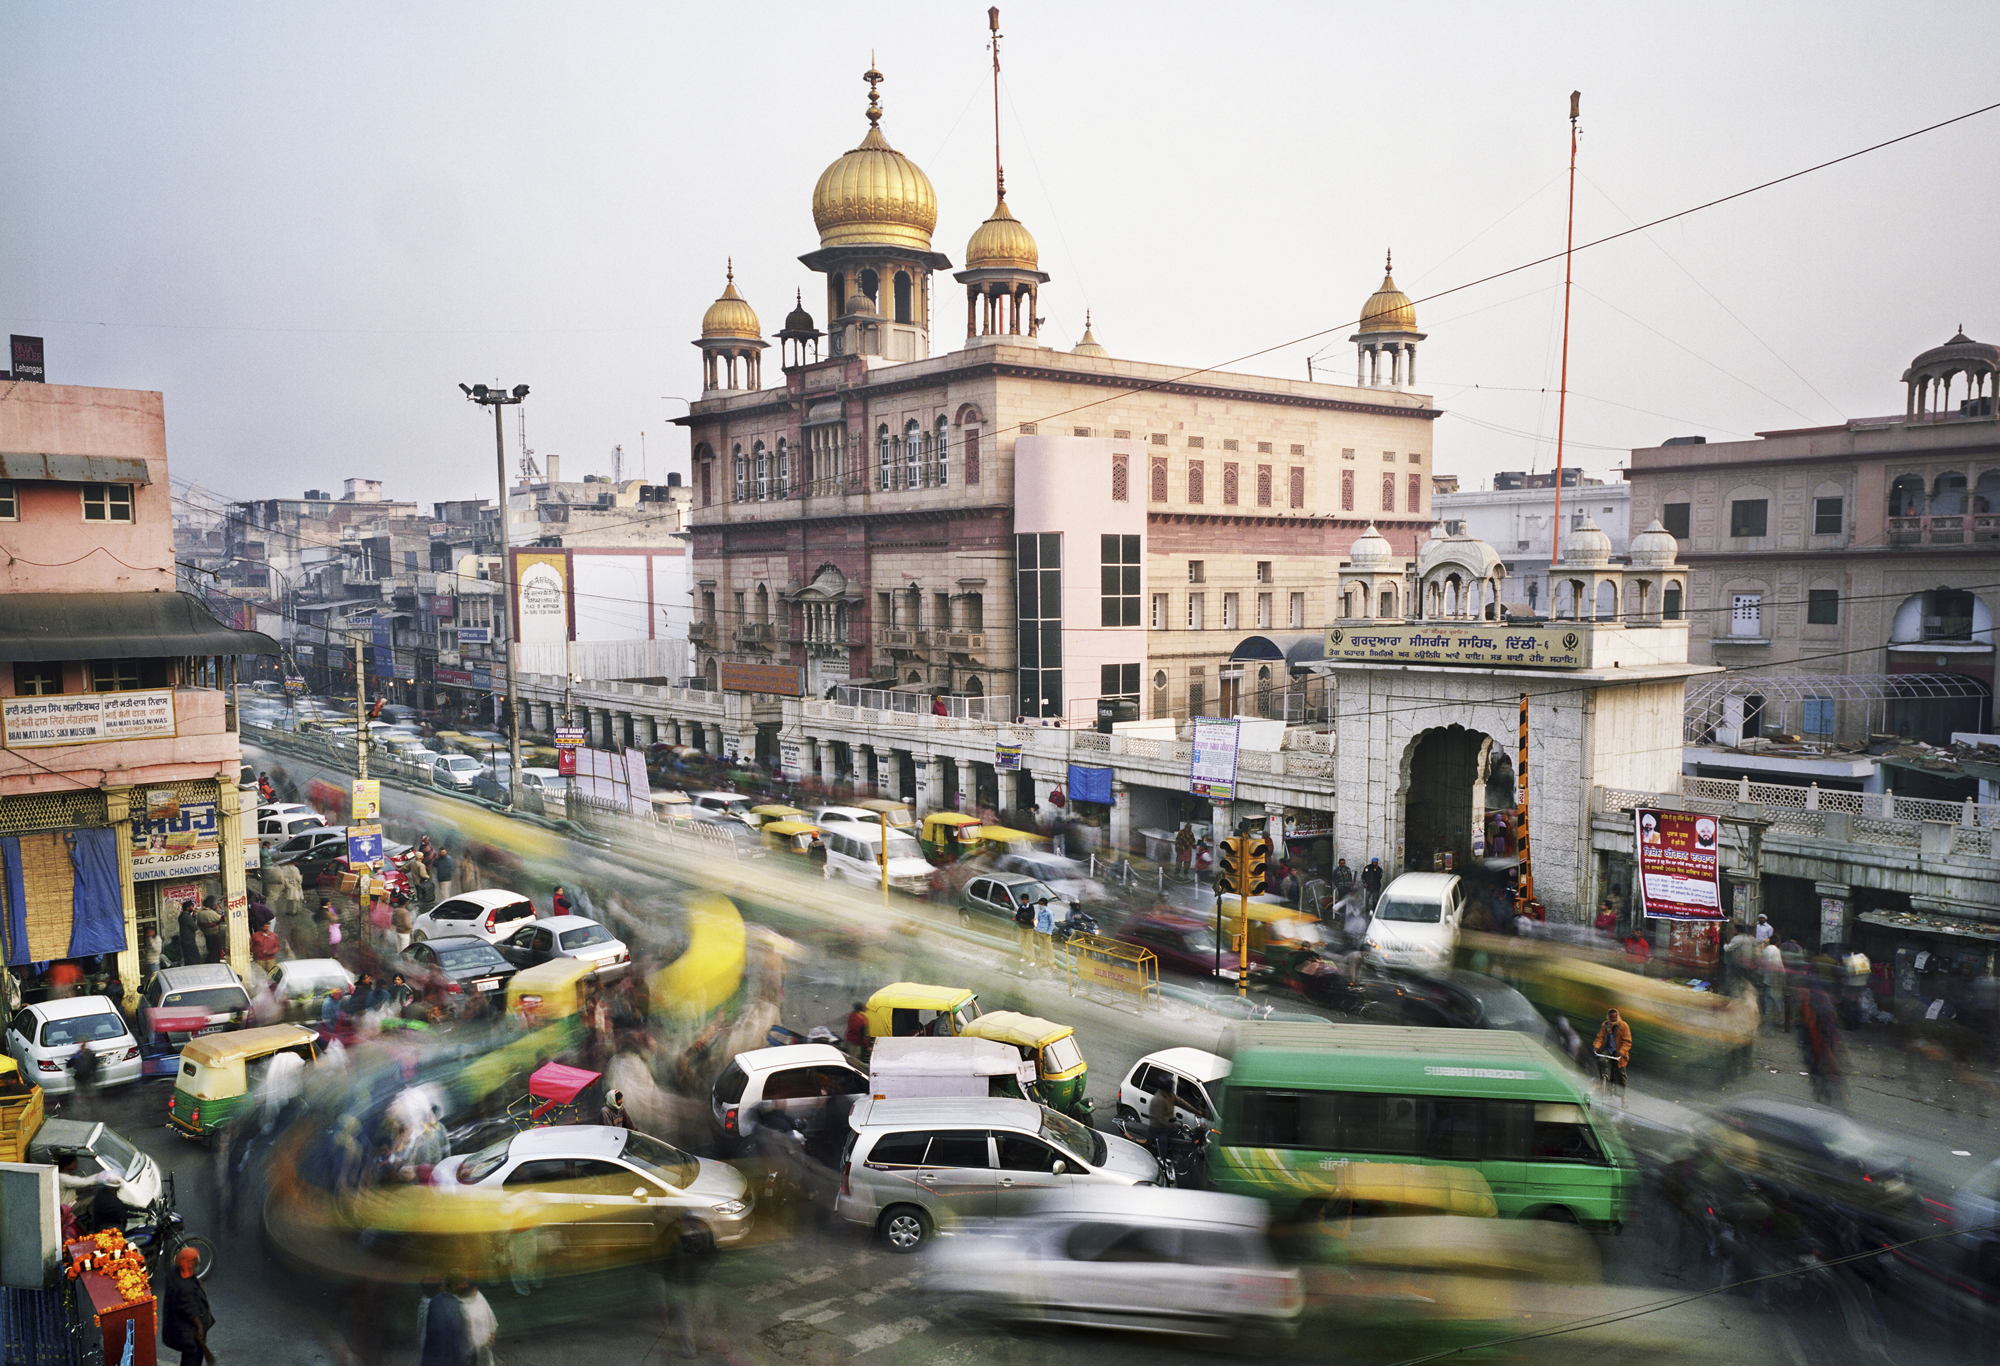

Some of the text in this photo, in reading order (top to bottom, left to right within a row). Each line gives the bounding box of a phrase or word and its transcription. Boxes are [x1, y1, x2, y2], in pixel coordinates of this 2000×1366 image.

[15, 363, 43, 375] Lehangas
[1350, 636, 1402, 647] ਗੁਰਦੁਆਰਾ
[1409, 634, 1451, 647] ਸੀਸਗੰਜ
[1458, 635, 1497, 650] ਸਾਹਿਬ,
[1329, 648, 1340, 656] ਤੇਗ
[5, 704, 19, 715] ਭਾਈ
[34, 705, 47, 714] ਦਾਸ
[104, 699, 118, 710] ਭਾਈ
[148, 697, 168, 706] ਨਿਵਾਸ
[35, 718, 48, 727] दास
[8, 726, 96, 740] BHAI MATI DASS SIKH MUSEUM
[131, 857, 154, 866] BLIC
[158, 852, 202, 863] ADDRESS
[1664, 846, 1689, 860] ਕੀਰਤਨ
[1690, 852, 1716, 864] ਦਰਬਾਰ
[132, 872, 167, 880] OUNTAIN,
[170, 866, 201, 876] CHANDNI
[203, 863, 220, 873] CHO
[228, 896, 246, 910] लस्सी
[1094, 968, 1124, 982] DELHI POLICE
